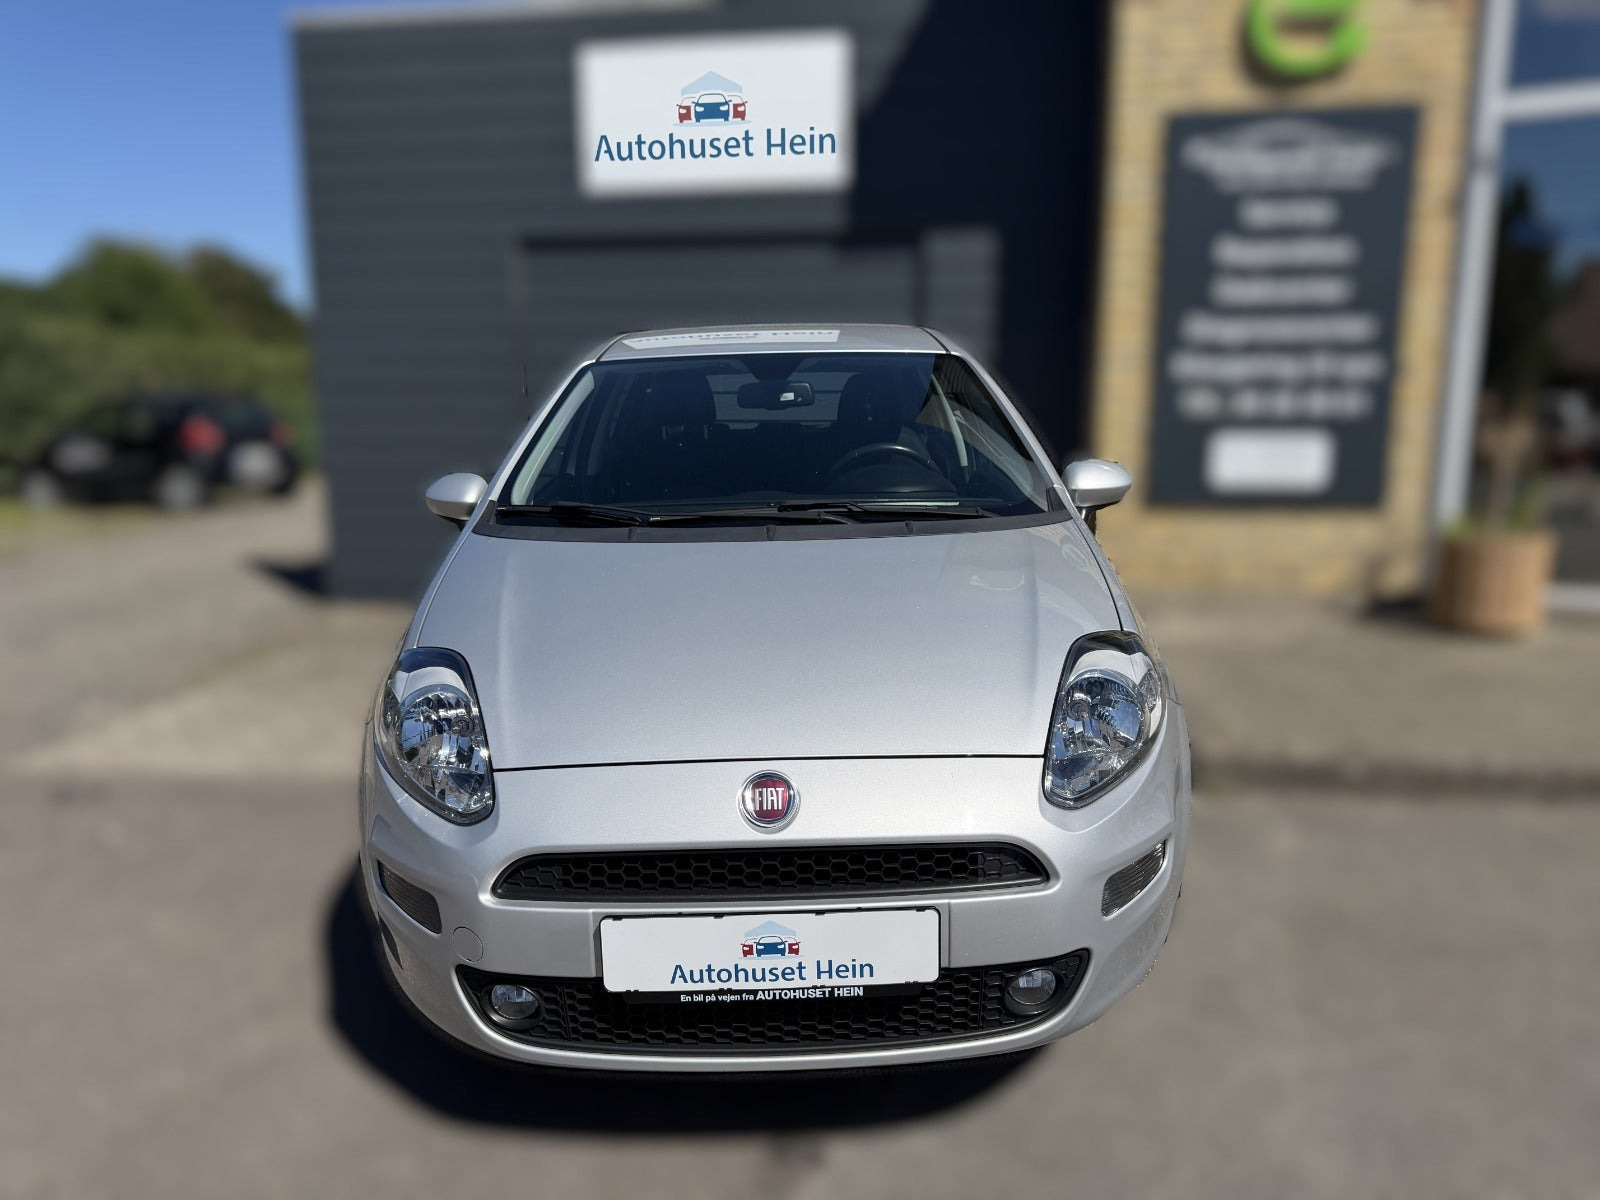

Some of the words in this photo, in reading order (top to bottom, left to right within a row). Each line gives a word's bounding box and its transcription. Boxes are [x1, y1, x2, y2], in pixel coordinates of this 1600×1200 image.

[594, 129, 754, 161] Autohuset
[766, 127, 836, 155] Hein
[754, 787, 784, 811] FIAT
[670, 962, 806, 984] Autohuset
[816, 959, 874, 979] Hein
[680, 994, 692, 1002] En
[693, 993, 704, 1002] bil
[705, 993, 716, 1003] på
[718, 993, 740, 1003] vejen
[742, 993, 754, 1001] fra
[756, 987, 832, 1000] AUTOHUSET
[834, 987, 864, 997] HEIN
